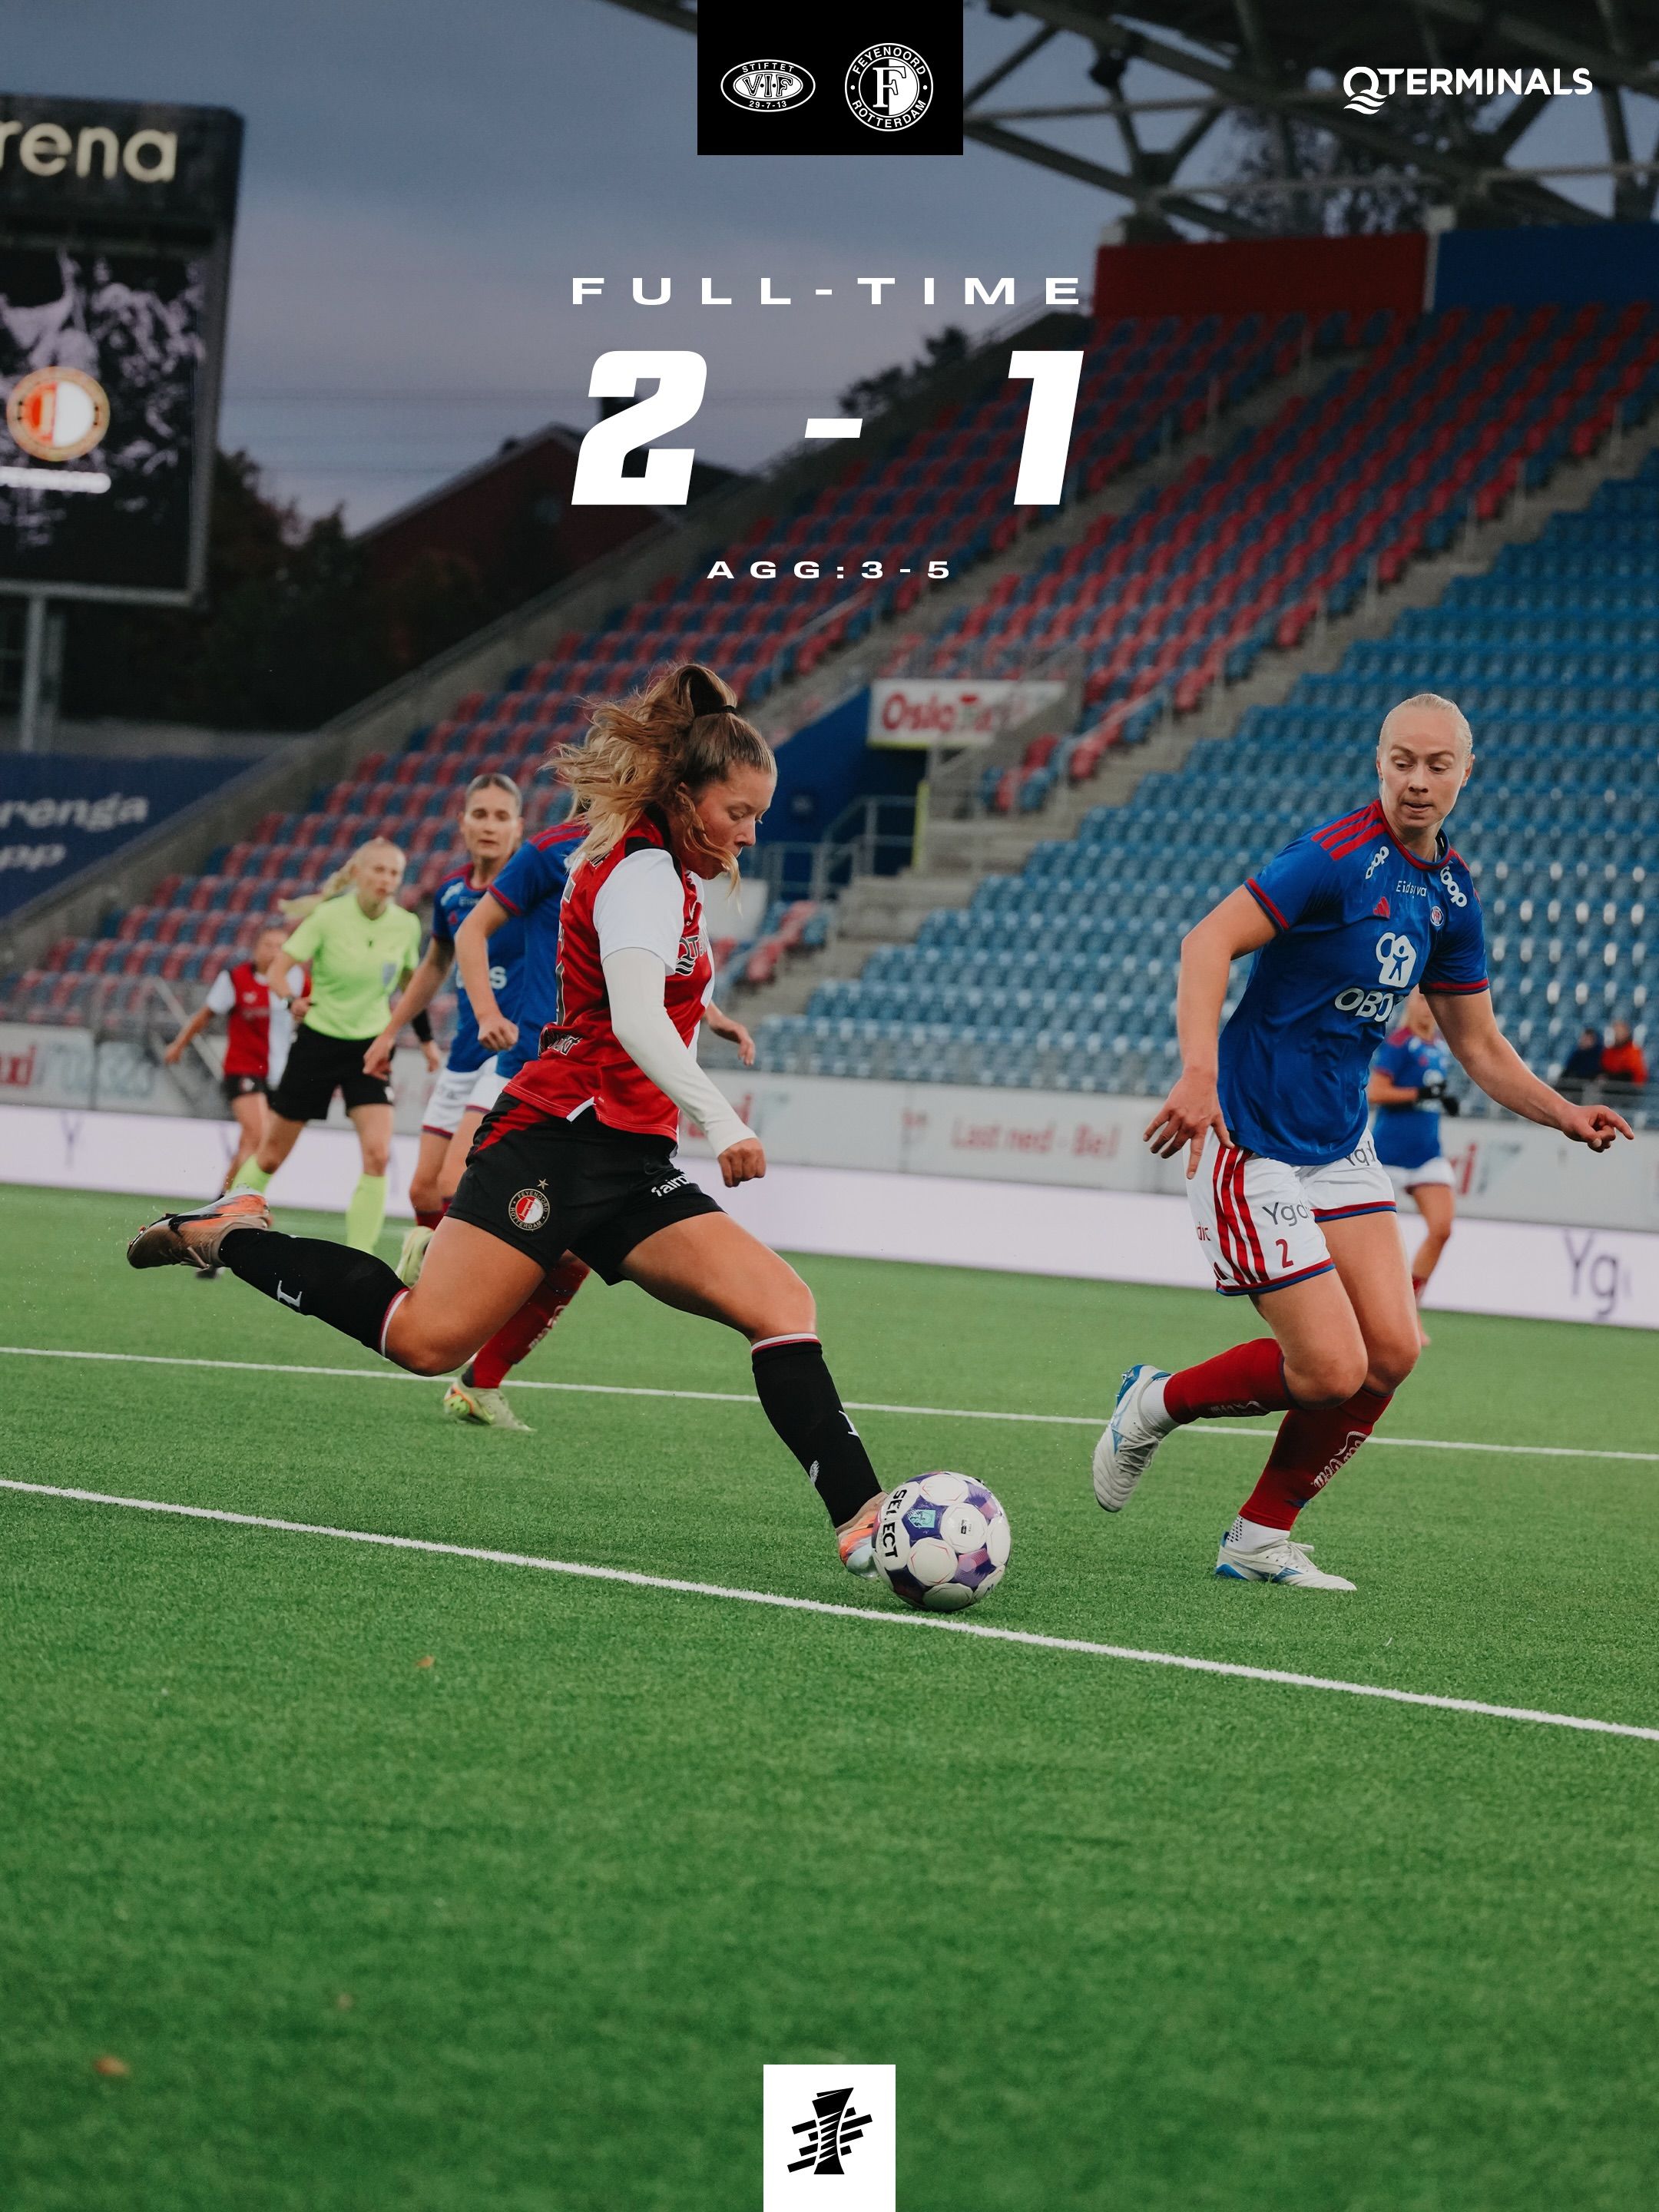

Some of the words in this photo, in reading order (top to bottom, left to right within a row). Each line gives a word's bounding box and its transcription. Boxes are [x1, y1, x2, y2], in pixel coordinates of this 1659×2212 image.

[517, 1190, 548, 1212] FEYENOORD
[510, 1207, 542, 1229] ROTTERDAM
[1275, 1238, 1294, 1269] 2
